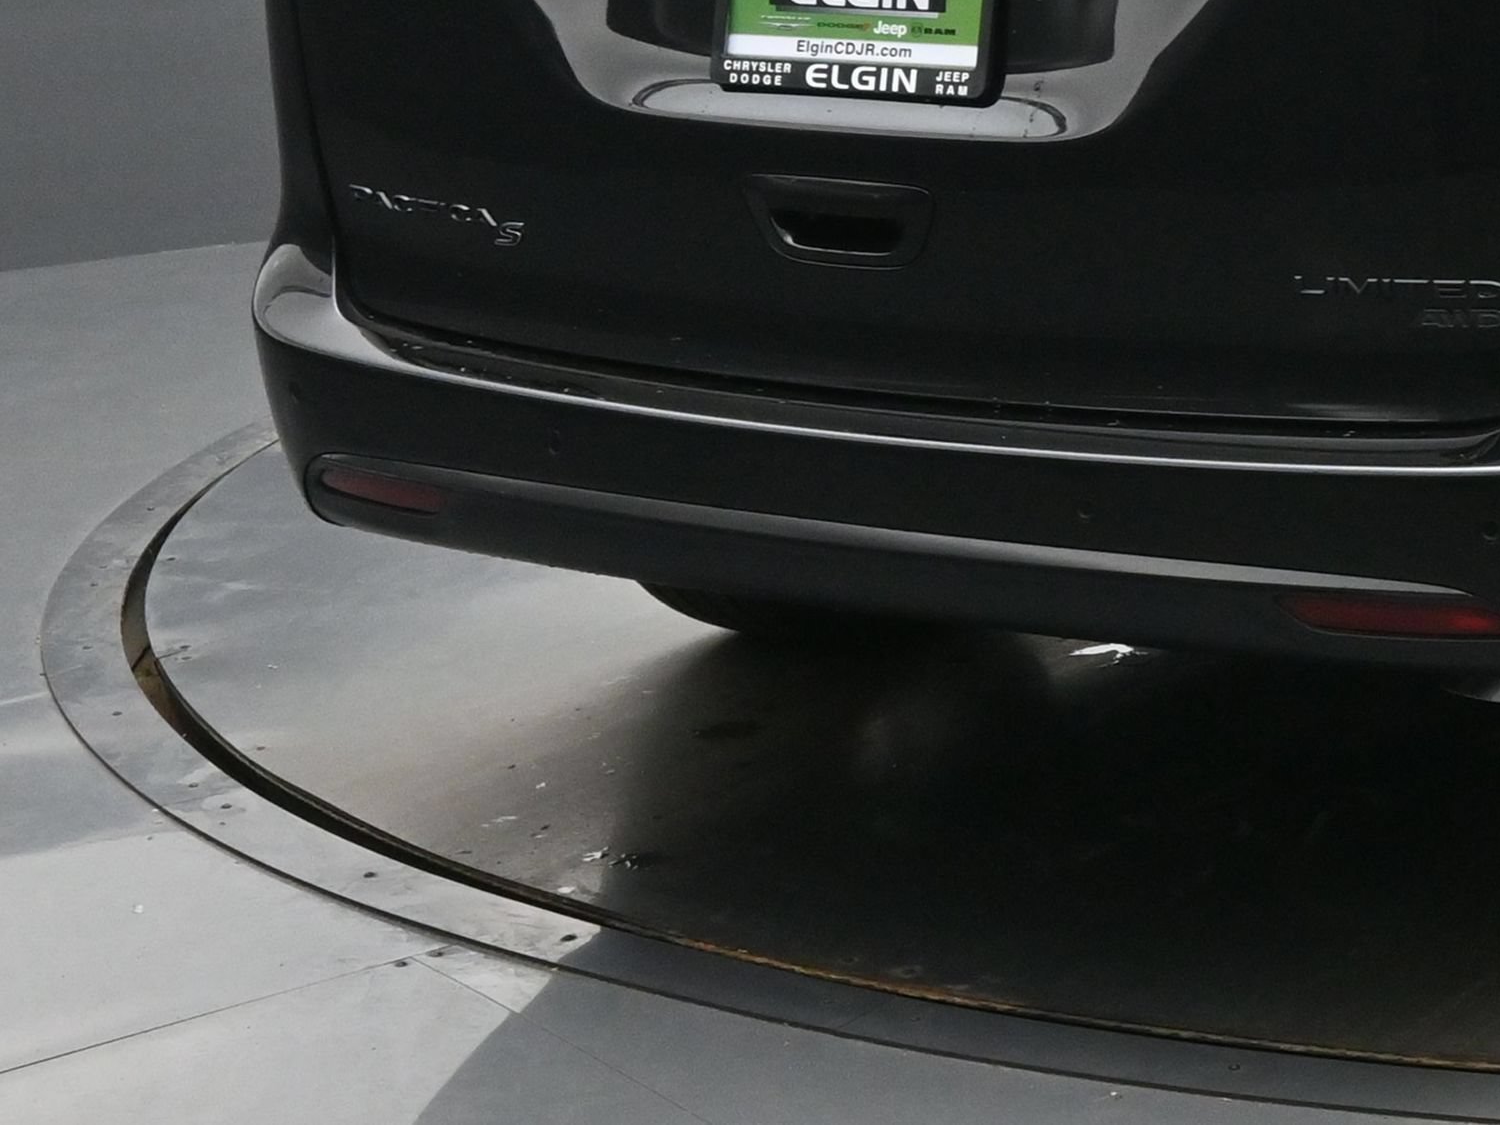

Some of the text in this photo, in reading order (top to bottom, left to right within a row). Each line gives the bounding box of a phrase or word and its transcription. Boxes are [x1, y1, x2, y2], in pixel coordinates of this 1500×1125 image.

[873, 20, 908, 39] Jeep
[923, 27, 957, 37] RAM
[796, 40, 913, 59] ElginCDJR.com
[723, 59, 792, 74] CHRYSLER
[729, 74, 783, 87] DODGE
[805, 63, 918, 94] ELGIN
[935, 71, 970, 84] JEEP
[935, 85, 969, 97] RAM
